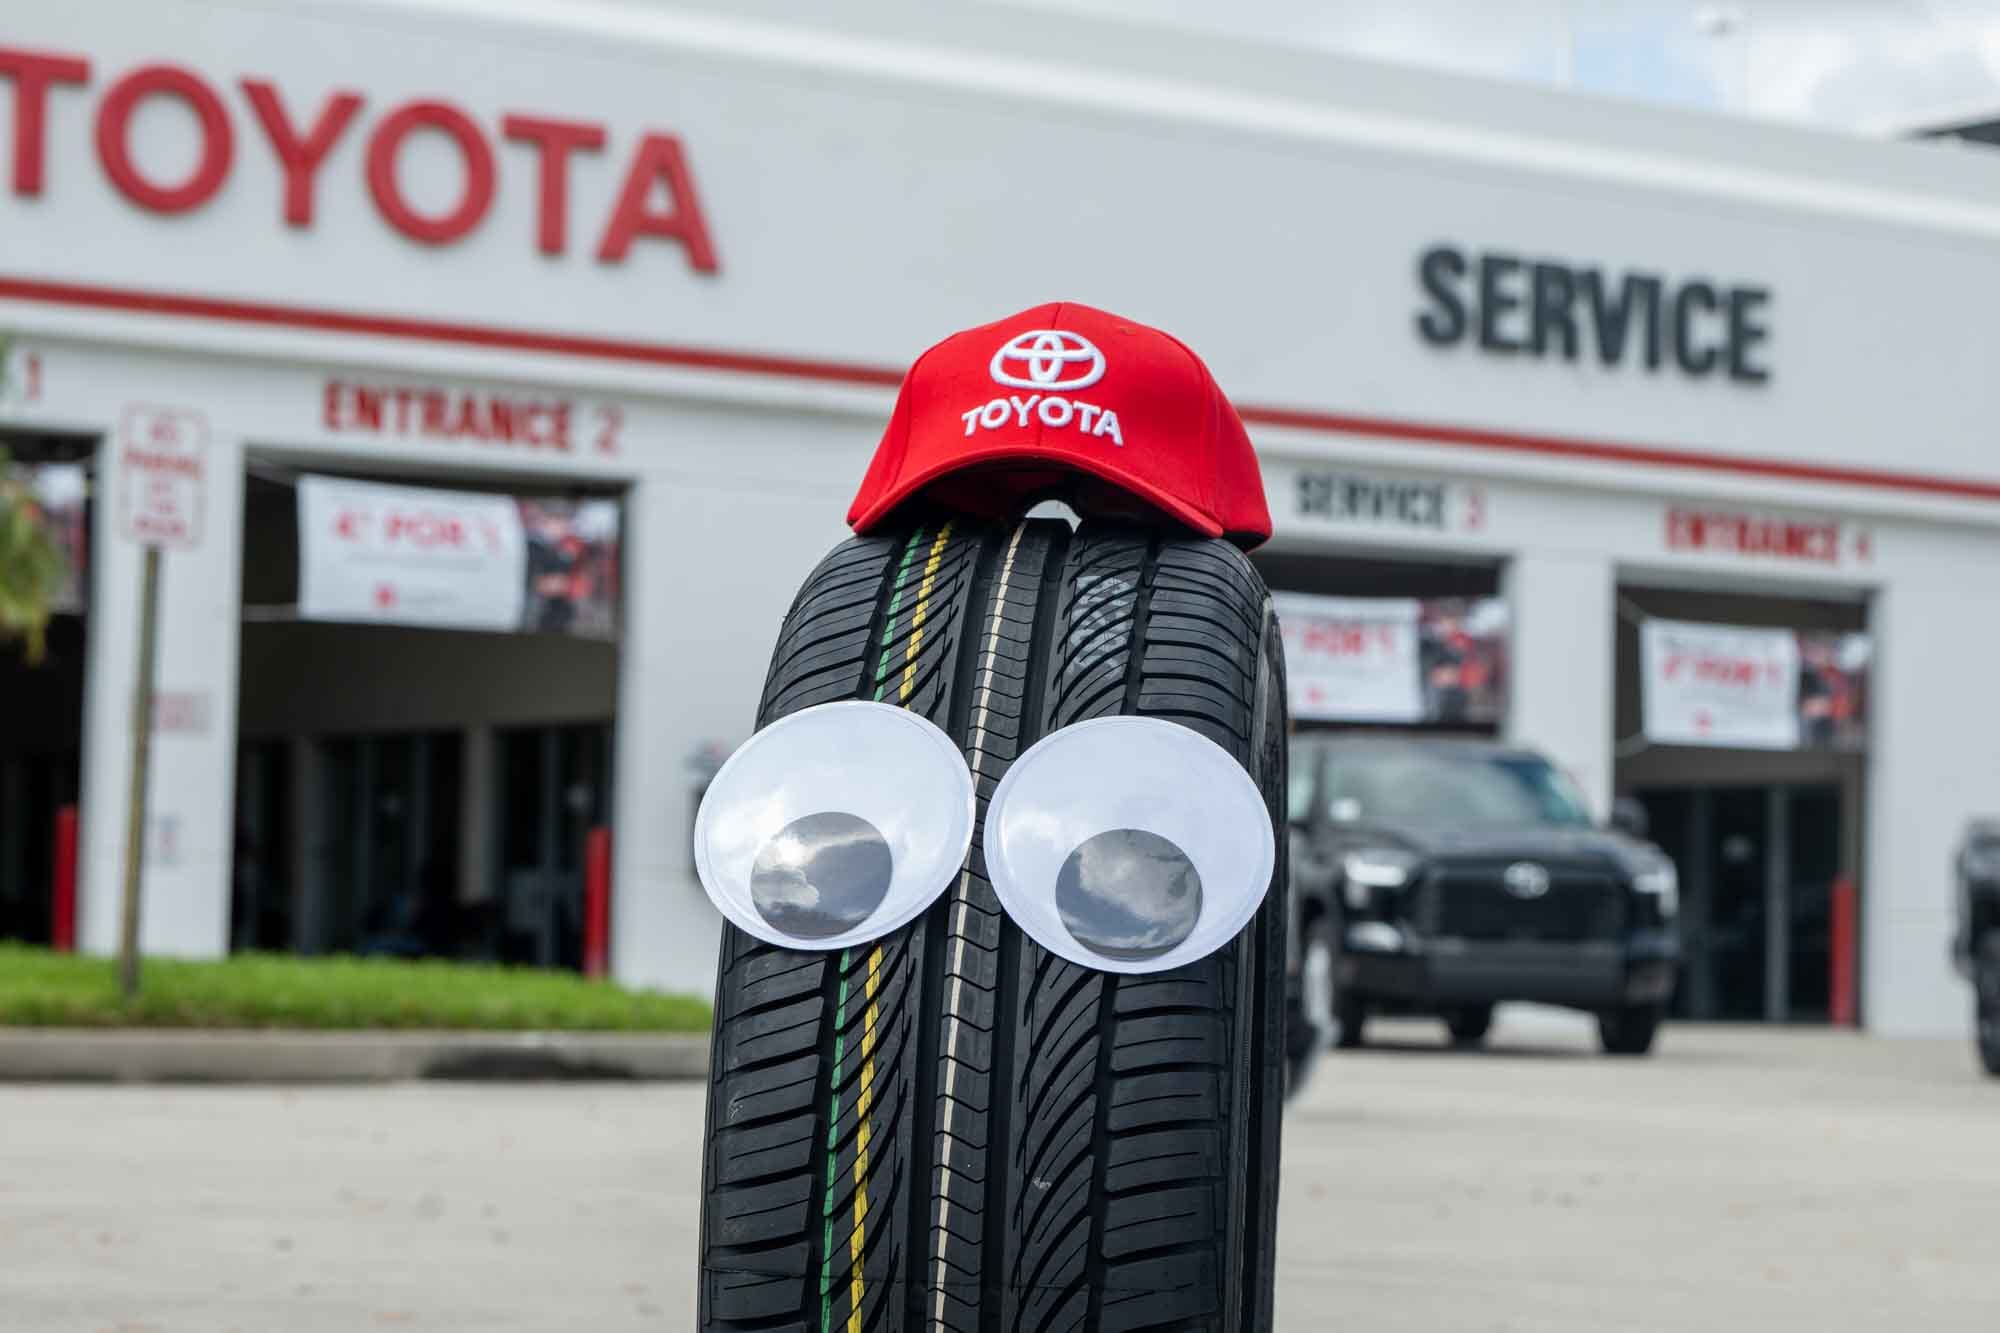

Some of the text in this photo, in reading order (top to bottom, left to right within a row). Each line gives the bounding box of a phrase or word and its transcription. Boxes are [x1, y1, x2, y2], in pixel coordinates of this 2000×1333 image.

[0, 46, 721, 277] TOYOTA
[1415, 244, 1772, 385] SERVICE
[323, 379, 624, 454] ENTRANCE 2
[961, 395, 1124, 446] TOYOTA
[1296, 473, 1443, 529] SERVICE
[1666, 508, 1838, 564] ENTRANCE
